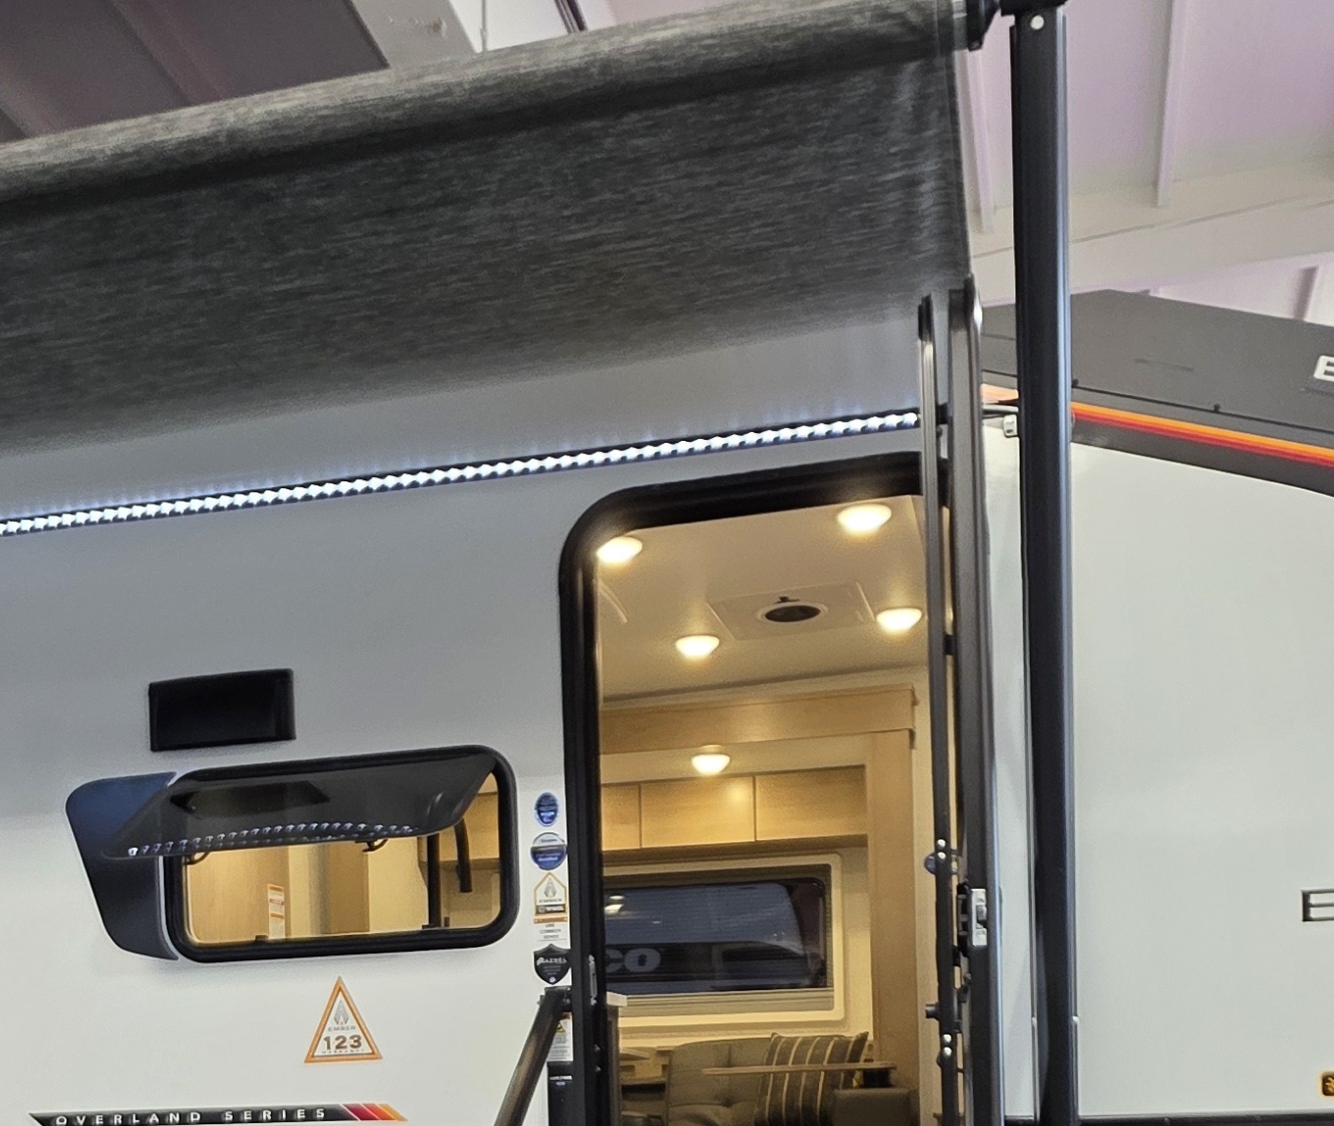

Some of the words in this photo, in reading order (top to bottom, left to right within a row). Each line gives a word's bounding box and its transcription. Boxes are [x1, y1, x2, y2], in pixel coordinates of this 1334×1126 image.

[324, 1034, 362, 1050] 123
[55, 1111, 201, 1126] OVERLAND
[225, 1108, 325, 1121] SERIES
